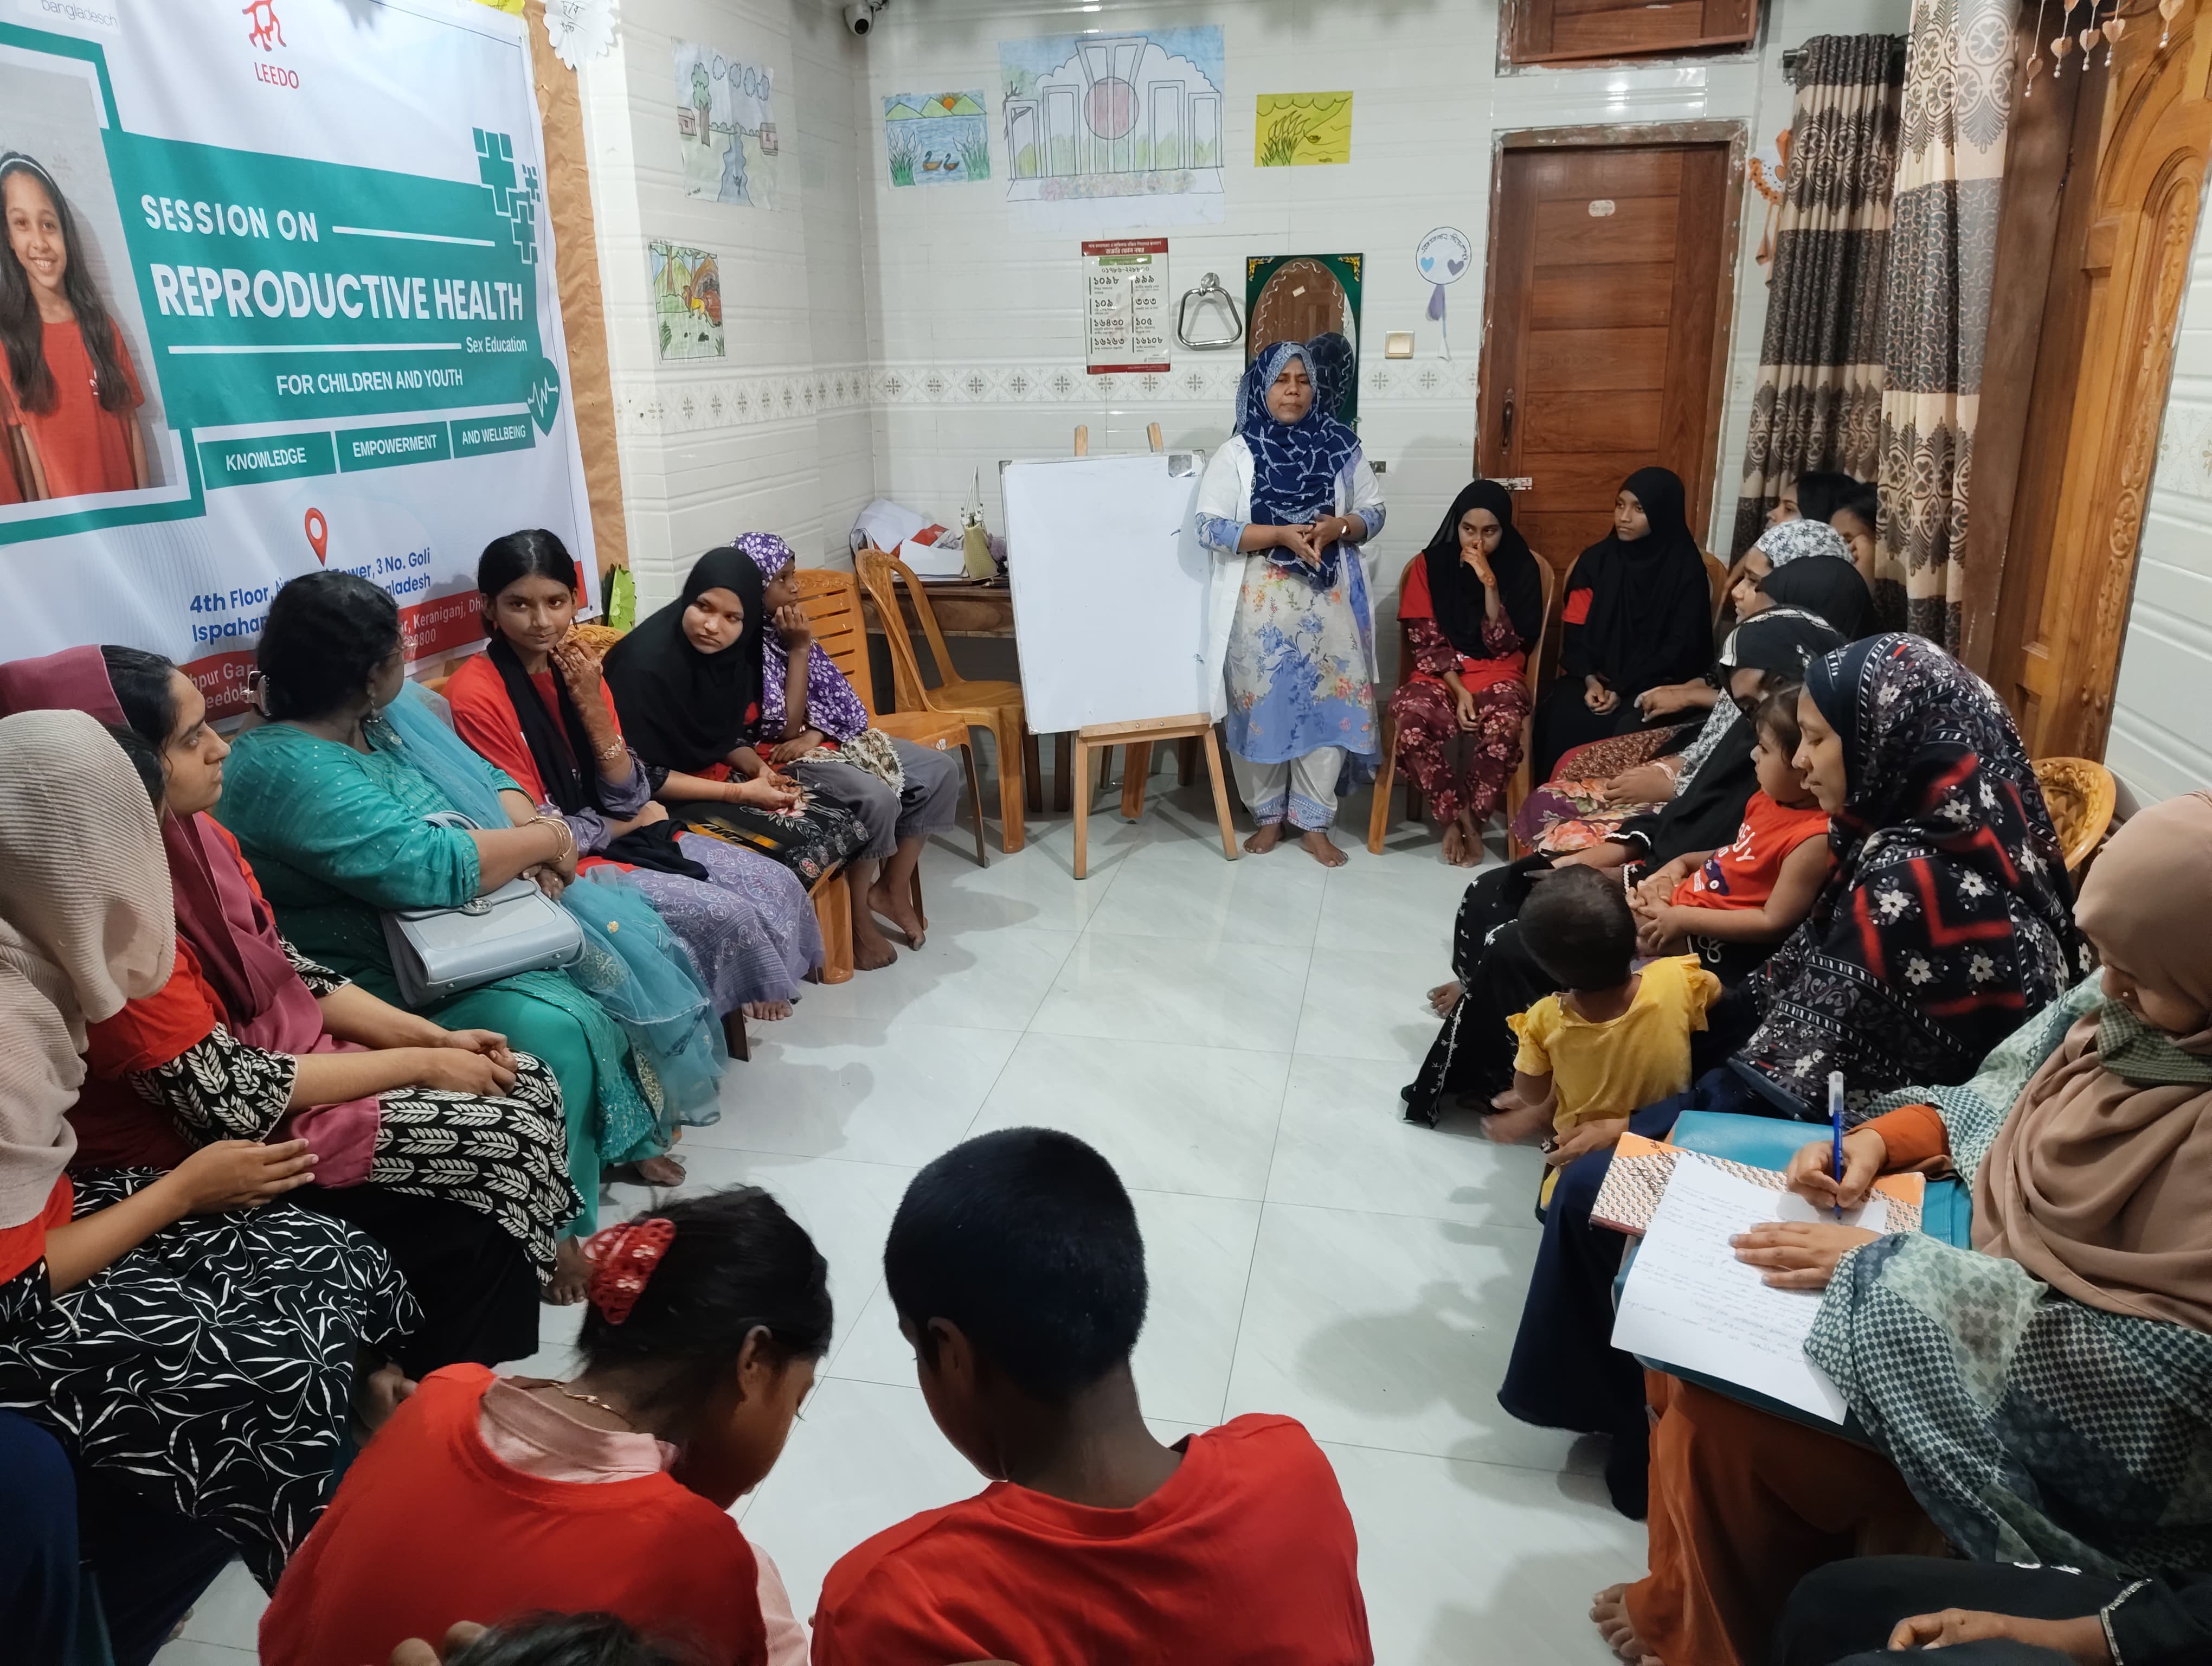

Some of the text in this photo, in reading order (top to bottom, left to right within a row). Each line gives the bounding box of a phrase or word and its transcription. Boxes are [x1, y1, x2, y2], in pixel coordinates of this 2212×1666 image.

[41, 0, 118, 27] bangladesch
[254, 62, 299, 89] LEEDO
[141, 194, 319, 243] SESSION ON
[1094, 276, 1119, 285] ১০৯৮
[1135, 275, 1154, 284] ৯৯৯
[150, 263, 524, 321] REPRODUCTIVE HEALTH
[1095, 299, 1113, 307] ১০৯
[466, 335, 528, 354] Sex Education
[1094, 337, 1124, 345] ১৬২৬৩
[1136, 336, 1163, 344] ১৬১০৮
[275, 368, 464, 396] FOR CHILDREN AND YOUTH
[352, 434, 438, 458] EMPOWERMENT
[462, 425, 526, 445] AND WELLBEING
[226, 447, 307, 471] KNOWLEDGE
[190, 593, 226, 613] 4th
[376, 558, 383, 575] 3
[384, 555, 406, 573] No.
[408, 547, 430, 567] Goli
